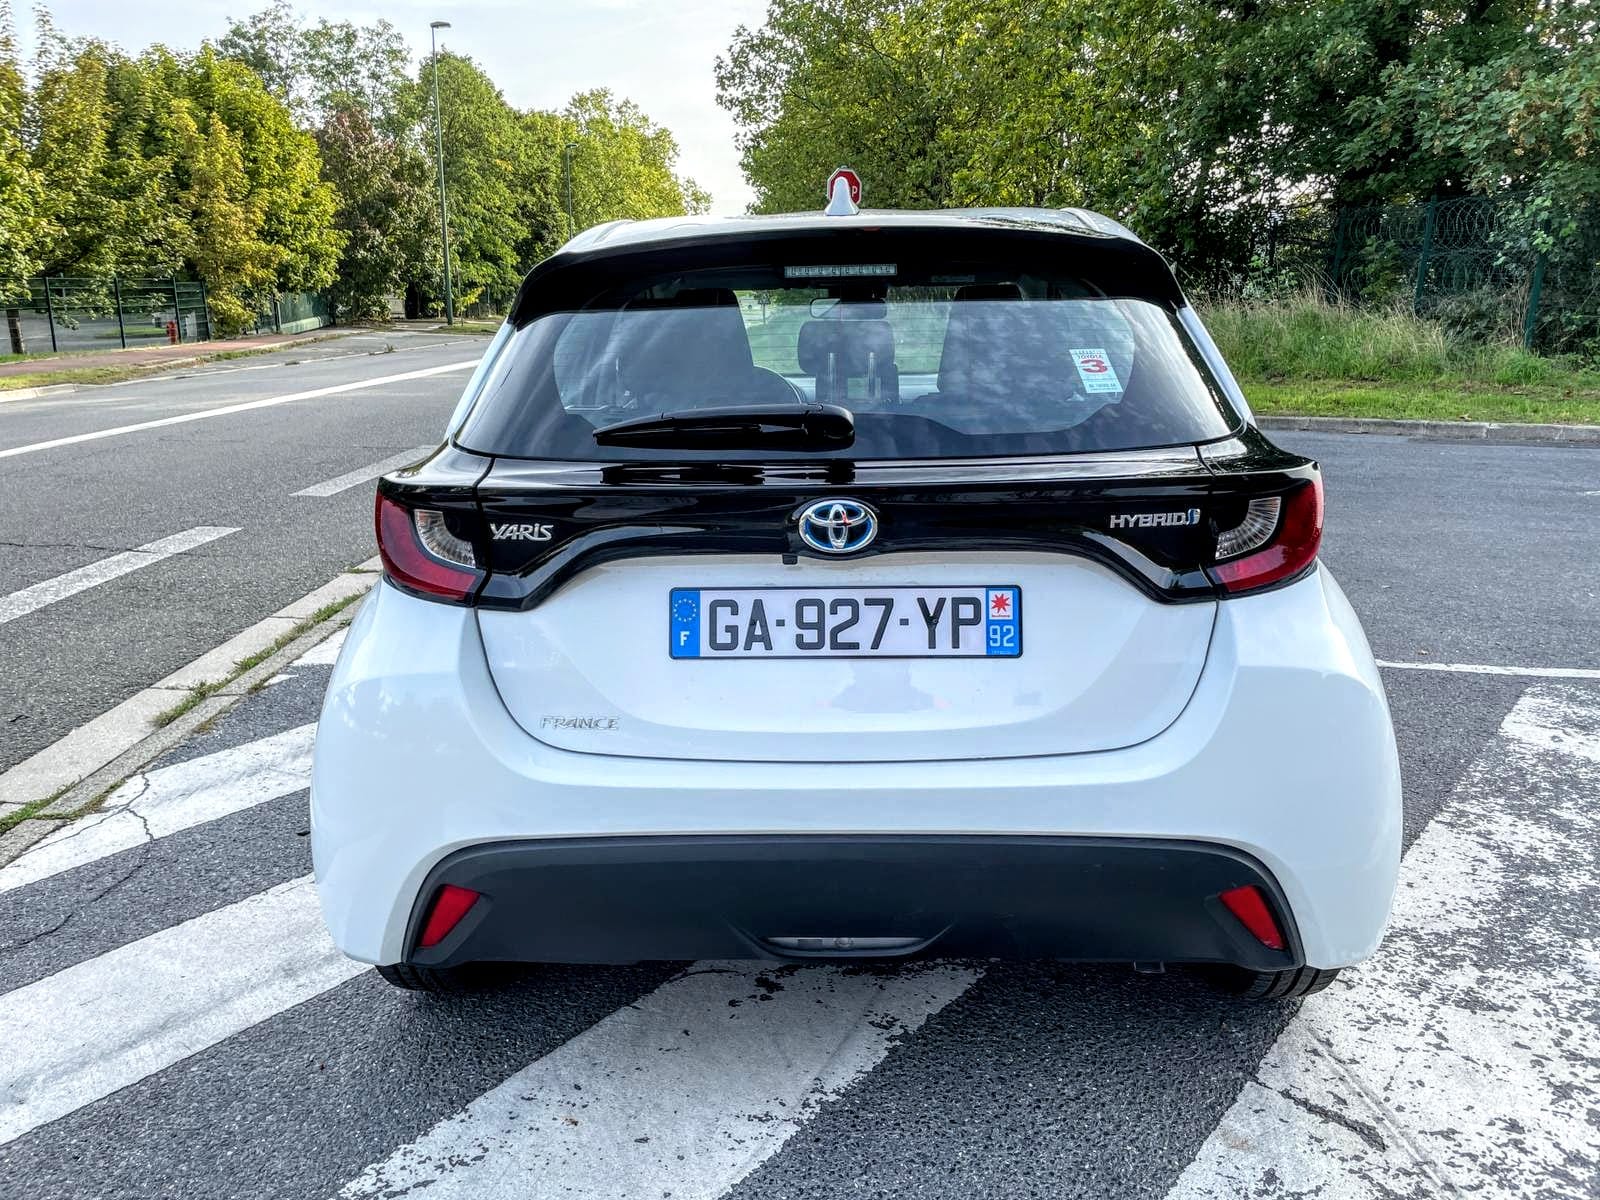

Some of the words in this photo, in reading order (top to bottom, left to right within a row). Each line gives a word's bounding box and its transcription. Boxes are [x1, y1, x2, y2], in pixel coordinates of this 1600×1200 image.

[1081, 359, 1108, 373] 3
[1109, 512, 1187, 529] HYBRID
[489, 523, 554, 541] YARIS
[708, 597, 982, 651] GA-927-YP
[680, 630, 690, 646] F
[989, 625, 1015, 647] 92
[541, 716, 619, 730] FRANCE
